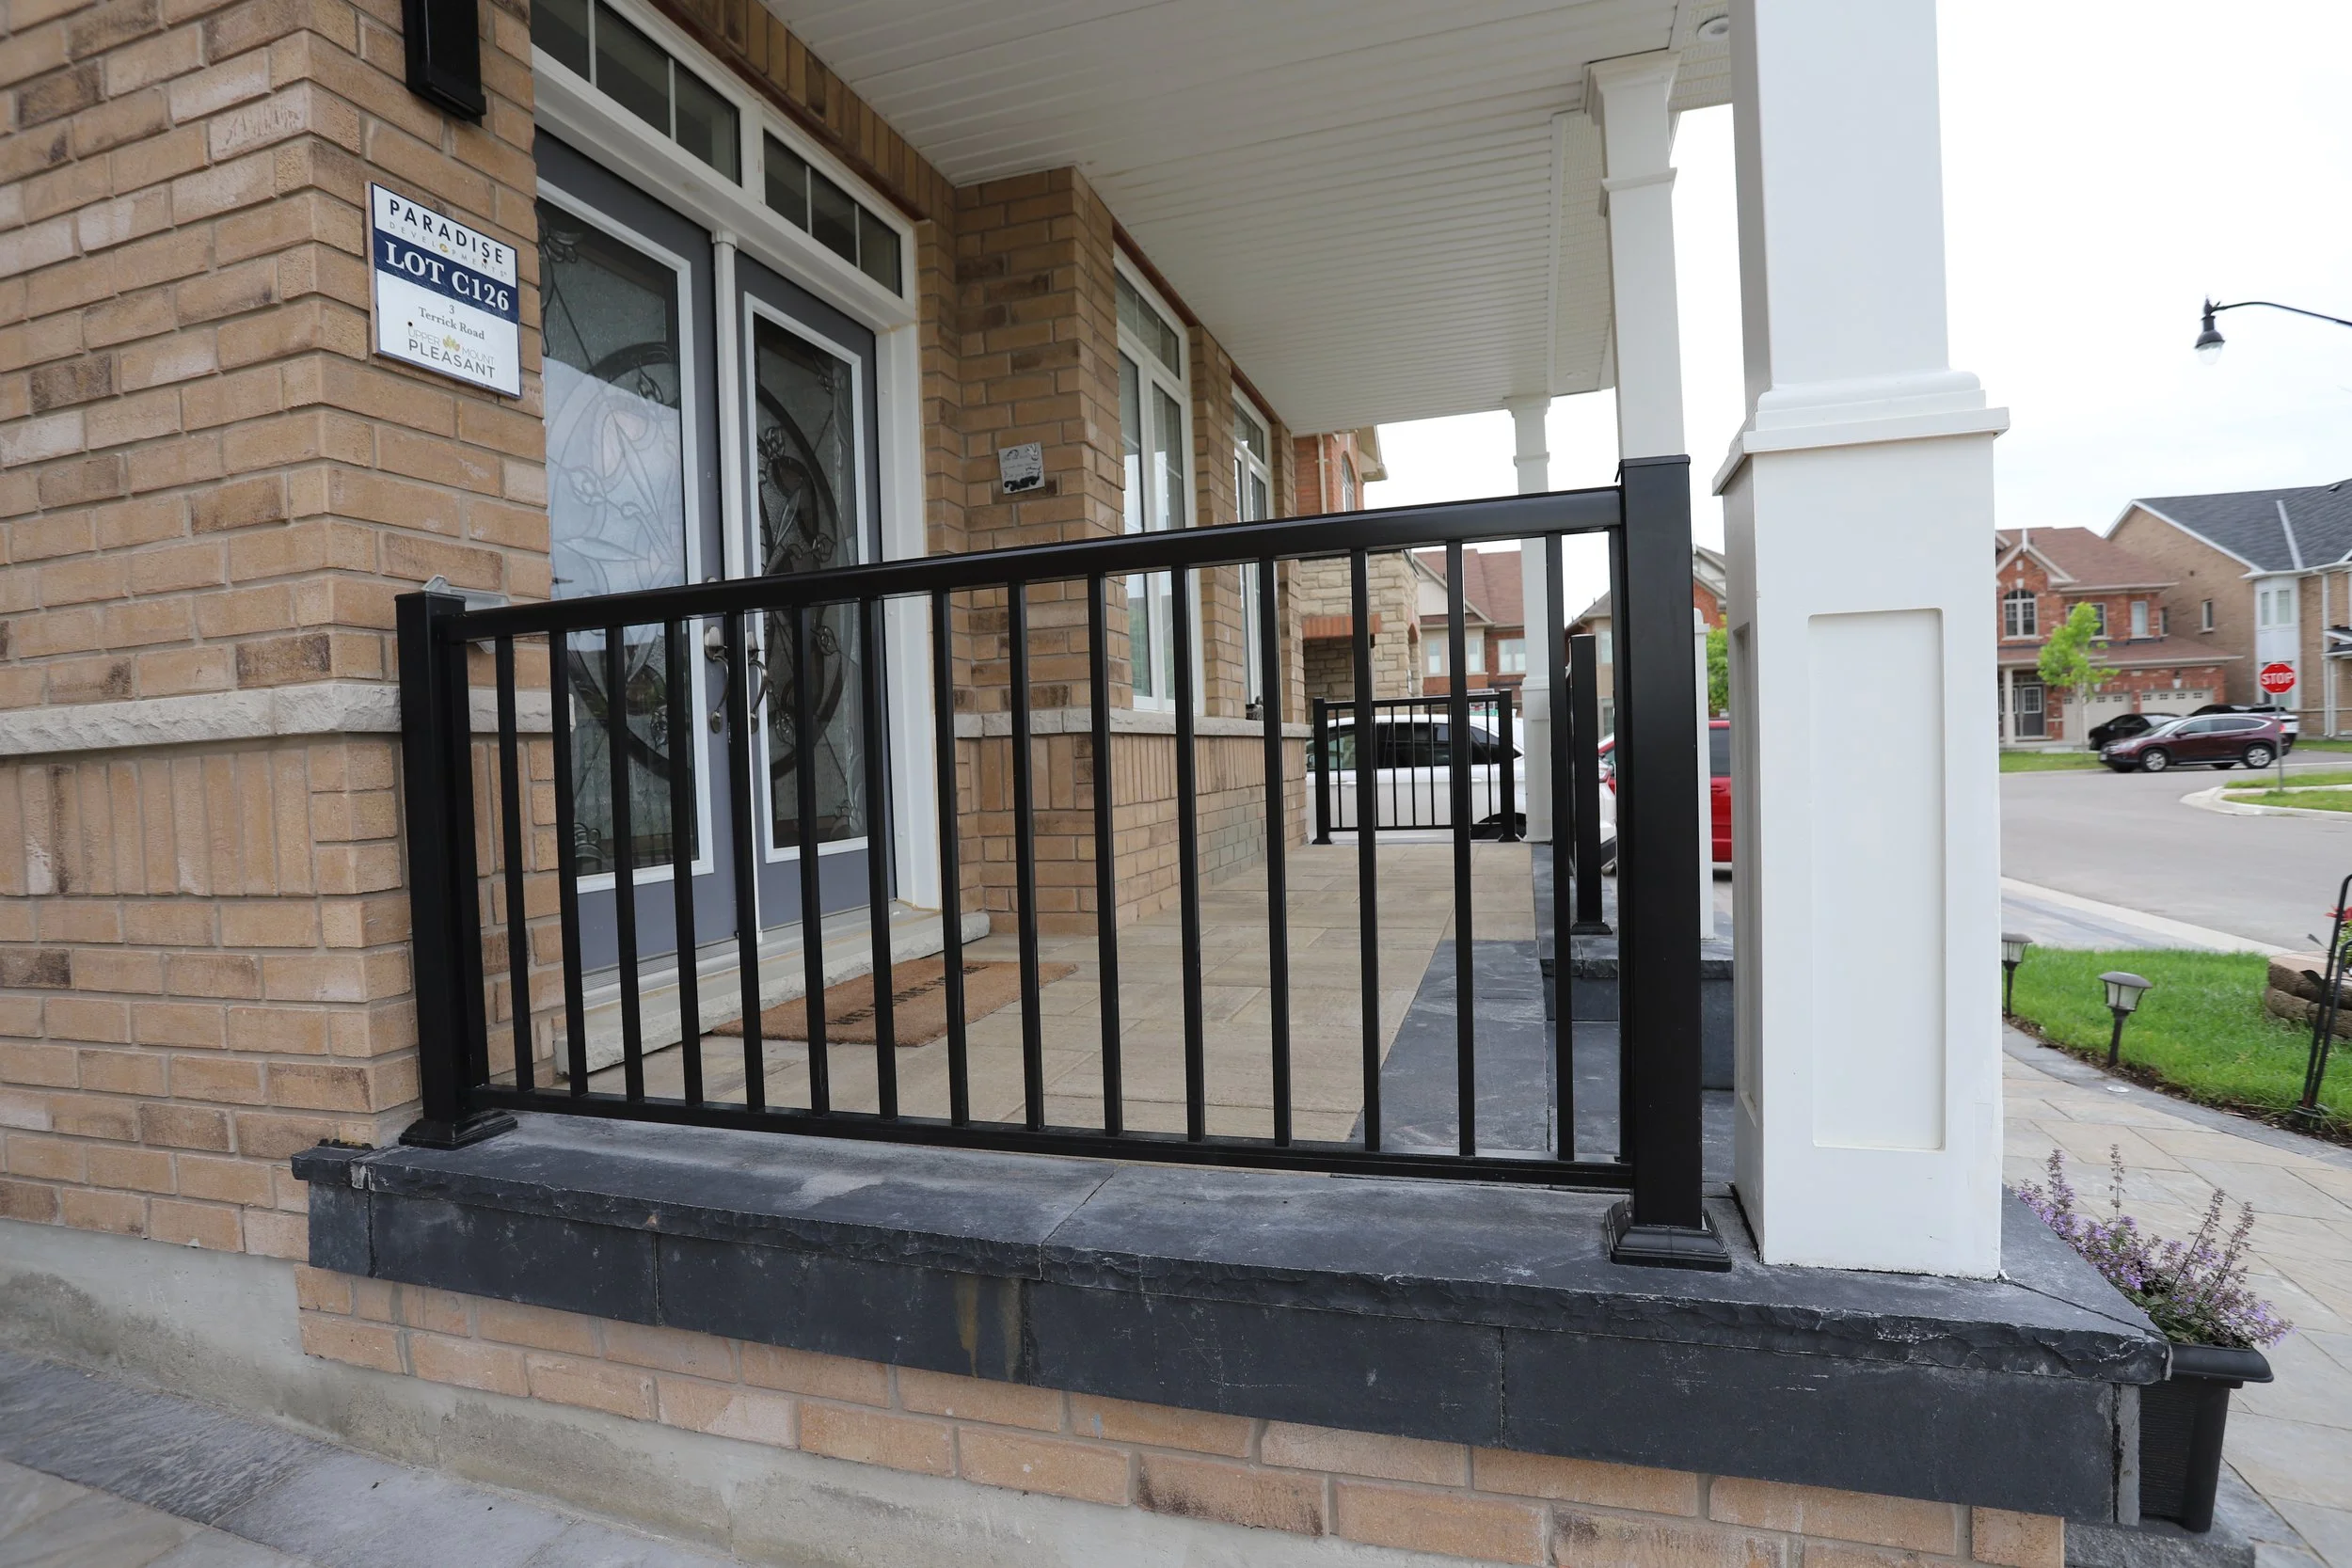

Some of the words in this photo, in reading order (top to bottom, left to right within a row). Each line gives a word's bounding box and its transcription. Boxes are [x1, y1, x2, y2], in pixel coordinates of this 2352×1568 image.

[389, 198, 503, 264] PARADISE
[386, 241, 444, 284] LOT
[452, 271, 510, 312] C126
[418, 307, 457, 329] Terrick
[459, 322, 485, 341] Road
[449, 305, 455, 314] 3
[408, 327, 440, 347] UPPER
[462, 347, 496, 366] MOUNT
[408, 338, 496, 378] PLEASANT
[2261, 672, 2294, 685] STOP
